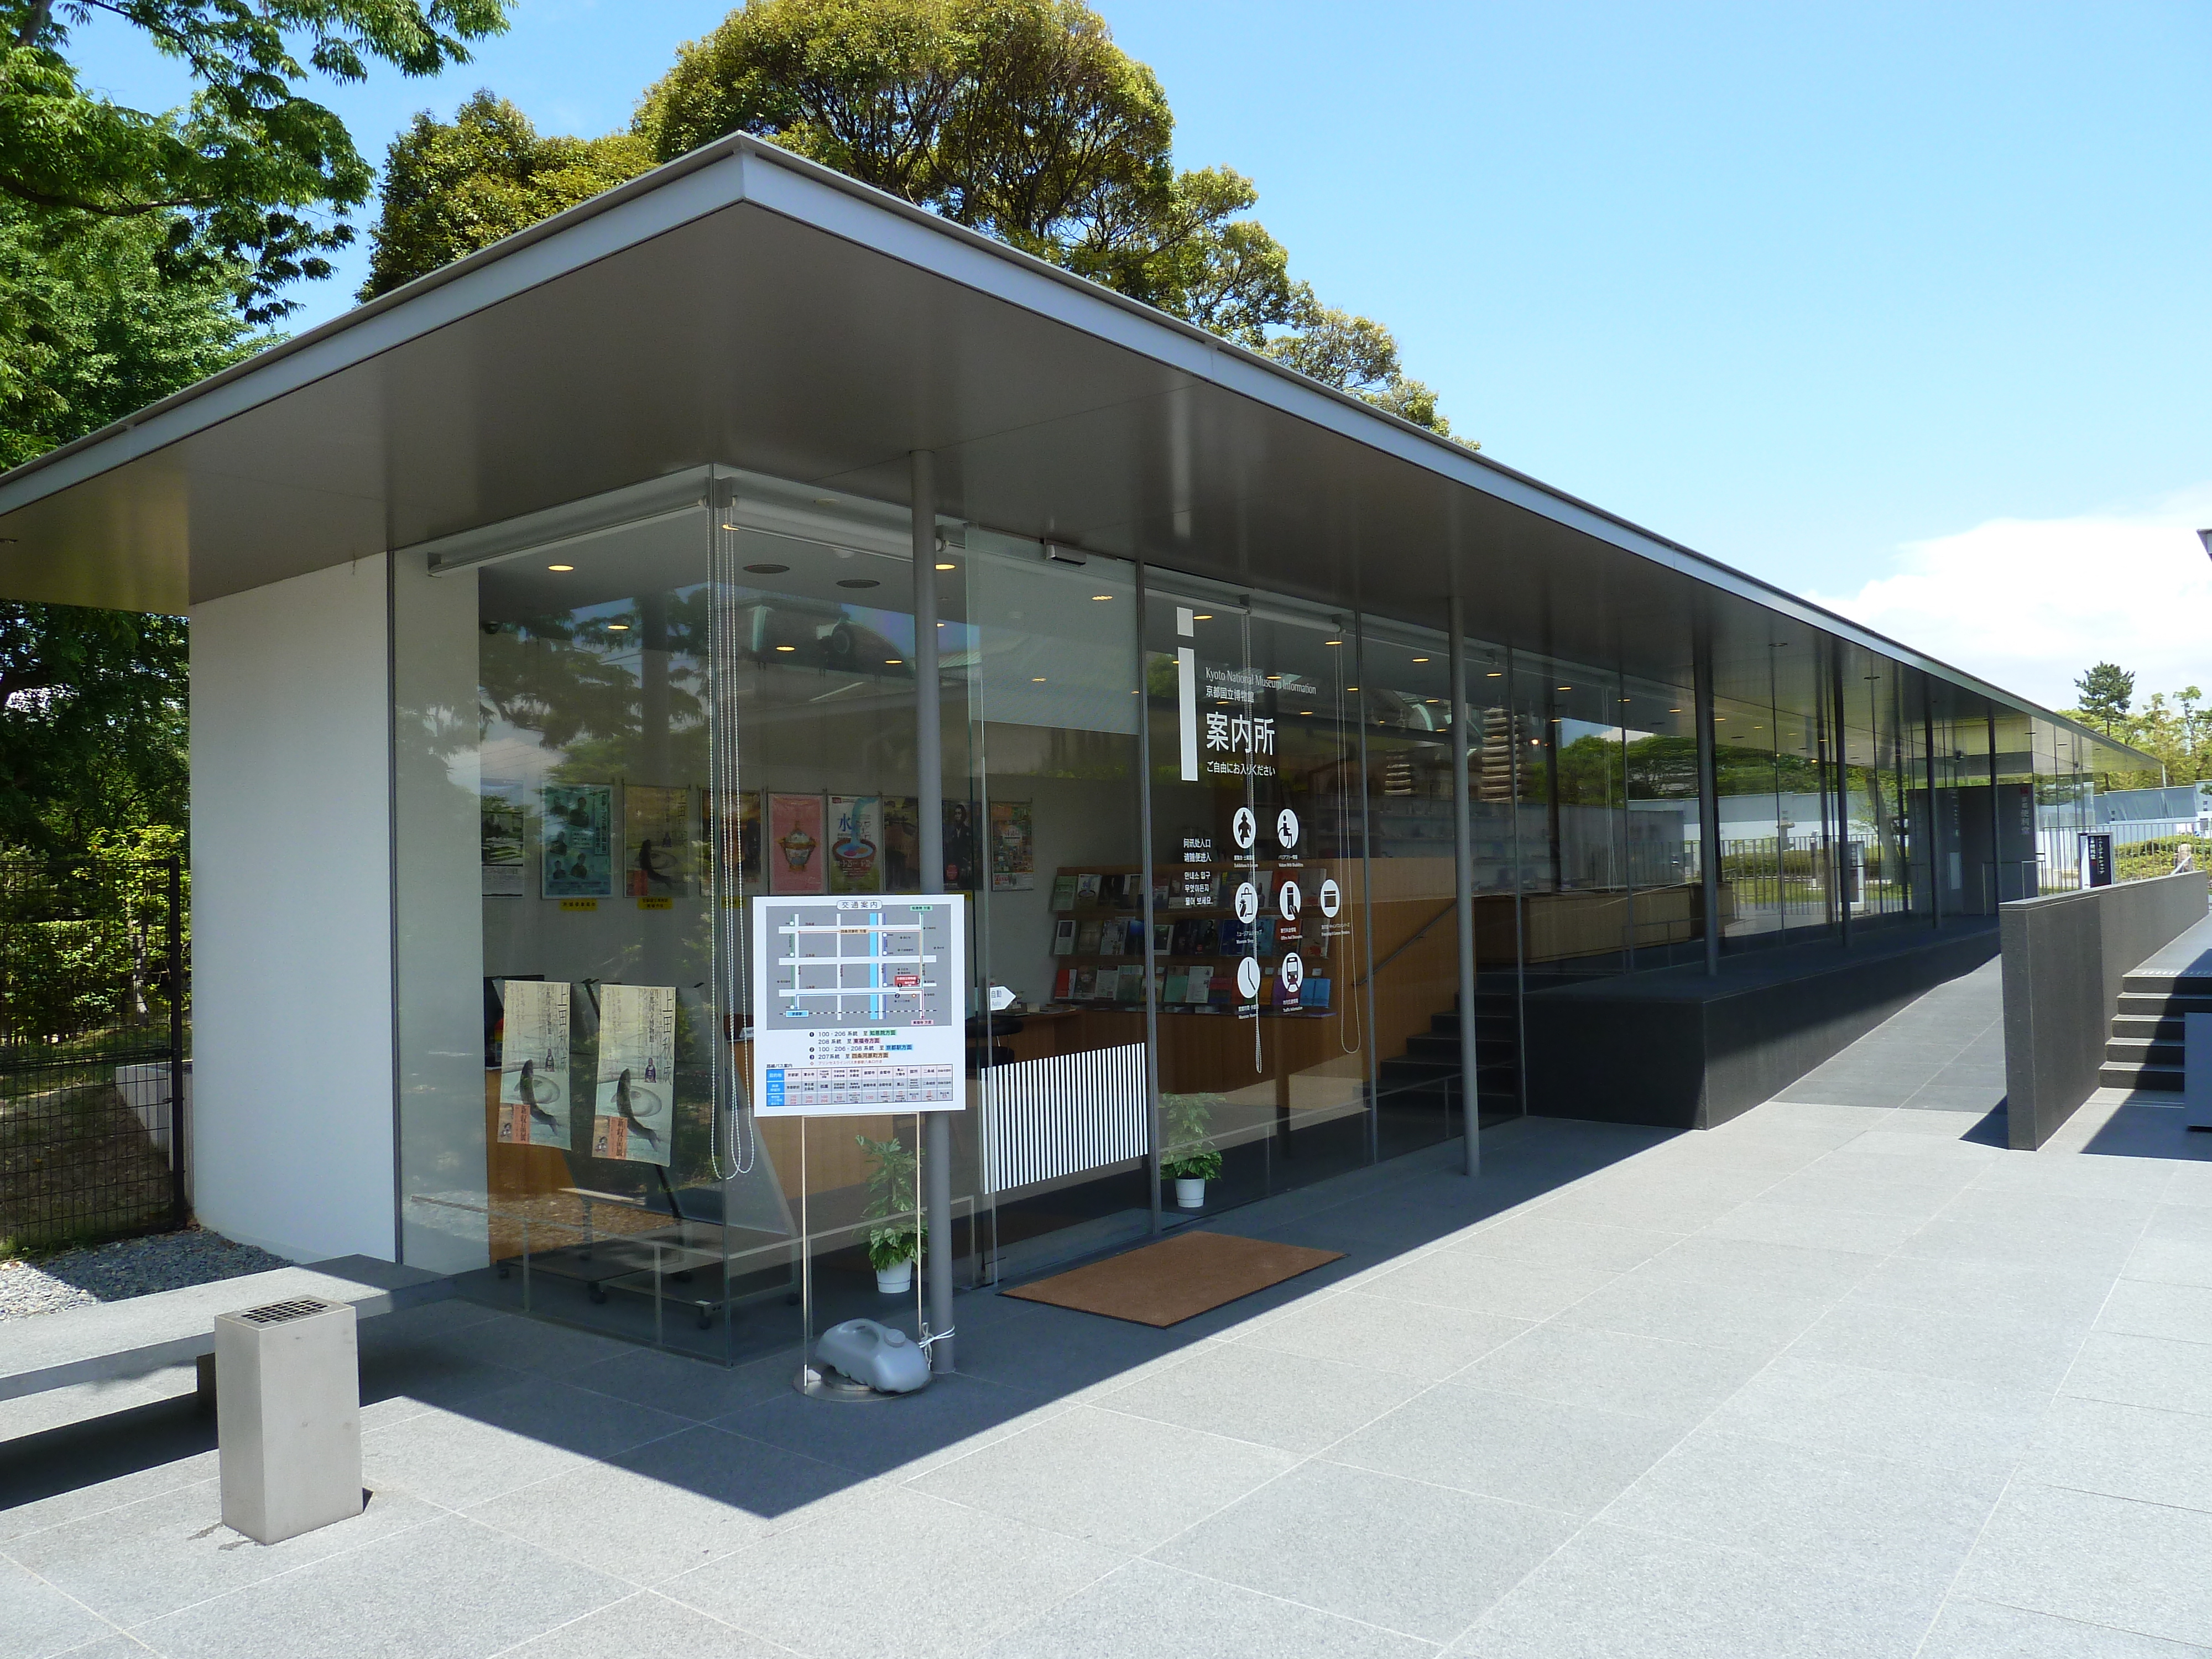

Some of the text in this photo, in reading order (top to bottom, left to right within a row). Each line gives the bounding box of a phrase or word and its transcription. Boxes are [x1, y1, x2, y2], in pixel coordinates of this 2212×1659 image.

[1206, 667, 1317, 695] Kyoto National Museum Information
[1206, 685, 1254, 703] 京都国立博物館
[1206, 711, 1275, 755] 案内所
[1207, 760, 1276, 776] ご自由にお入りください
[837, 813, 852, 831] 水
[1184, 872, 1199, 880] 안내소
[1185, 884, 1209, 893] 무엇이든지
[991, 989, 1002, 998] 自動
